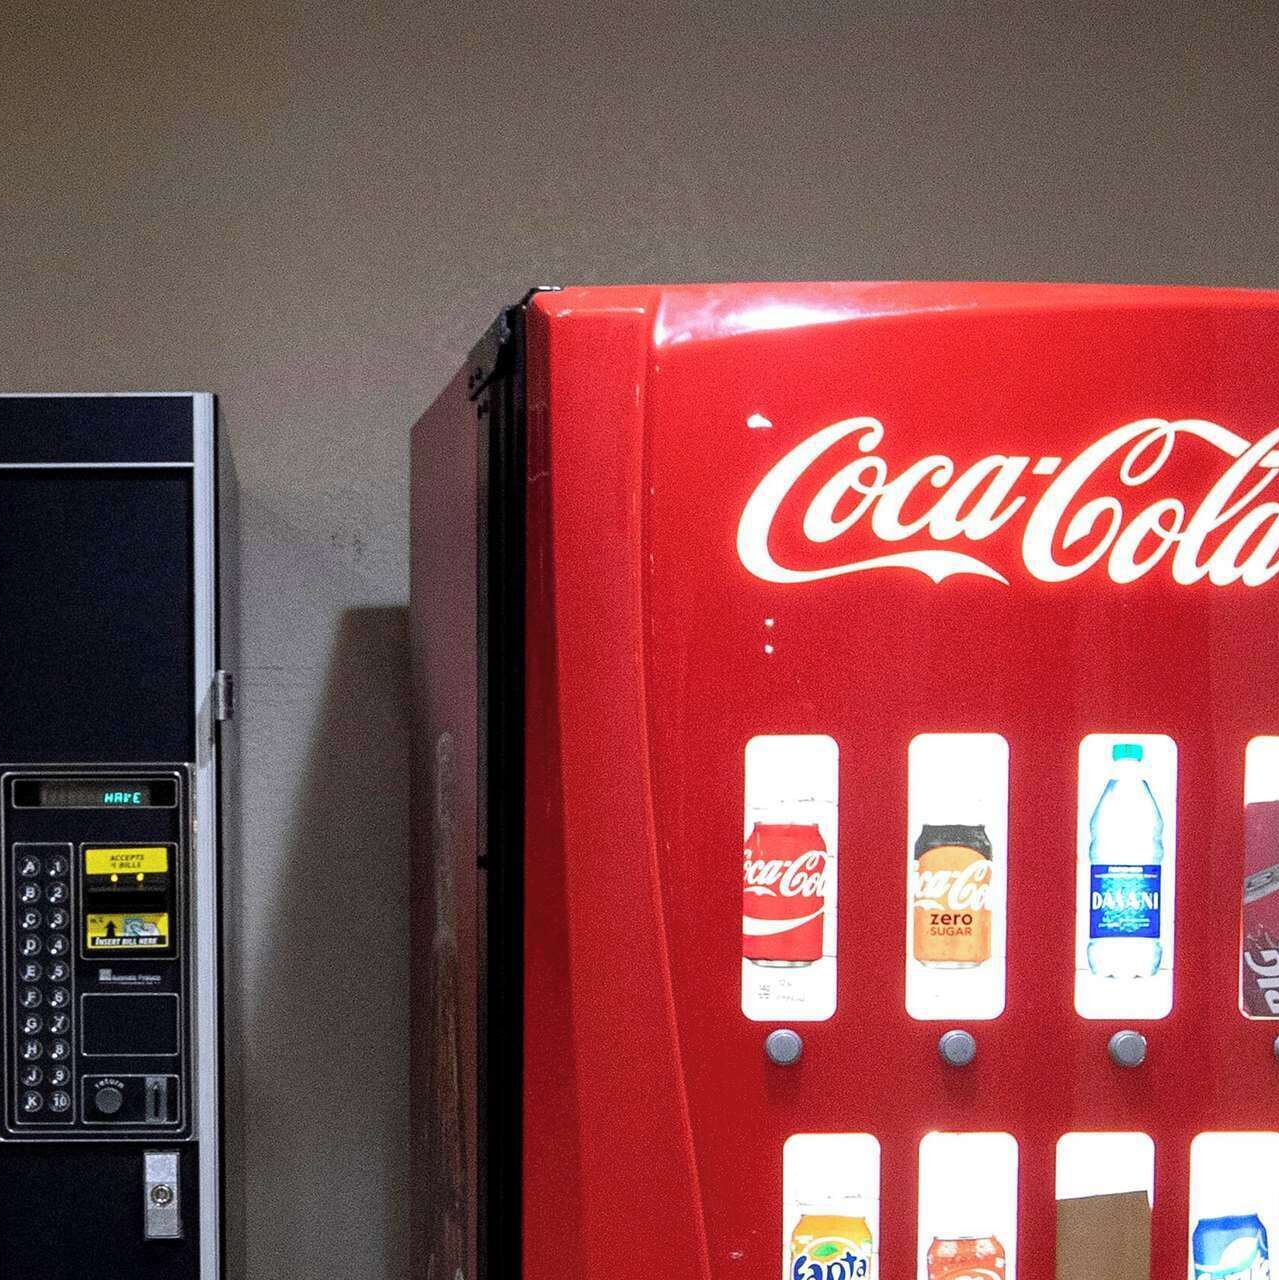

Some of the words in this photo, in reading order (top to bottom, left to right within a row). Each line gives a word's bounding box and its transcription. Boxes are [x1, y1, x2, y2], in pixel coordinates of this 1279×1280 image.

[103, 792, 141, 804] HAVE
[26, 861, 36, 872] A
[55, 861, 61, 872] 1
[26, 887, 36, 898] B
[54, 887, 62, 898] 2
[26, 913, 36, 924] C
[54, 913, 62, 924] 3
[930, 912, 973, 926] zero
[930, 926, 972, 937] SUGAR
[27, 939, 36, 950] D
[55, 940, 62, 950] 4
[27, 965, 36, 976] E
[55, 965, 63, 976] 5
[27, 991, 36, 1002] F
[55, 991, 63, 1002] 6
[27, 1018, 37, 1029] G
[54, 1016, 64, 1028] 7
[27, 1044, 37, 1055] H
[56, 1044, 64, 1055] 8
[29, 1070, 36, 1081] J
[56, 1070, 64, 1081] 9
[94, 1078, 124, 1090] return
[28, 1096, 37, 1106] K
[54, 1095, 66, 1107] 10
